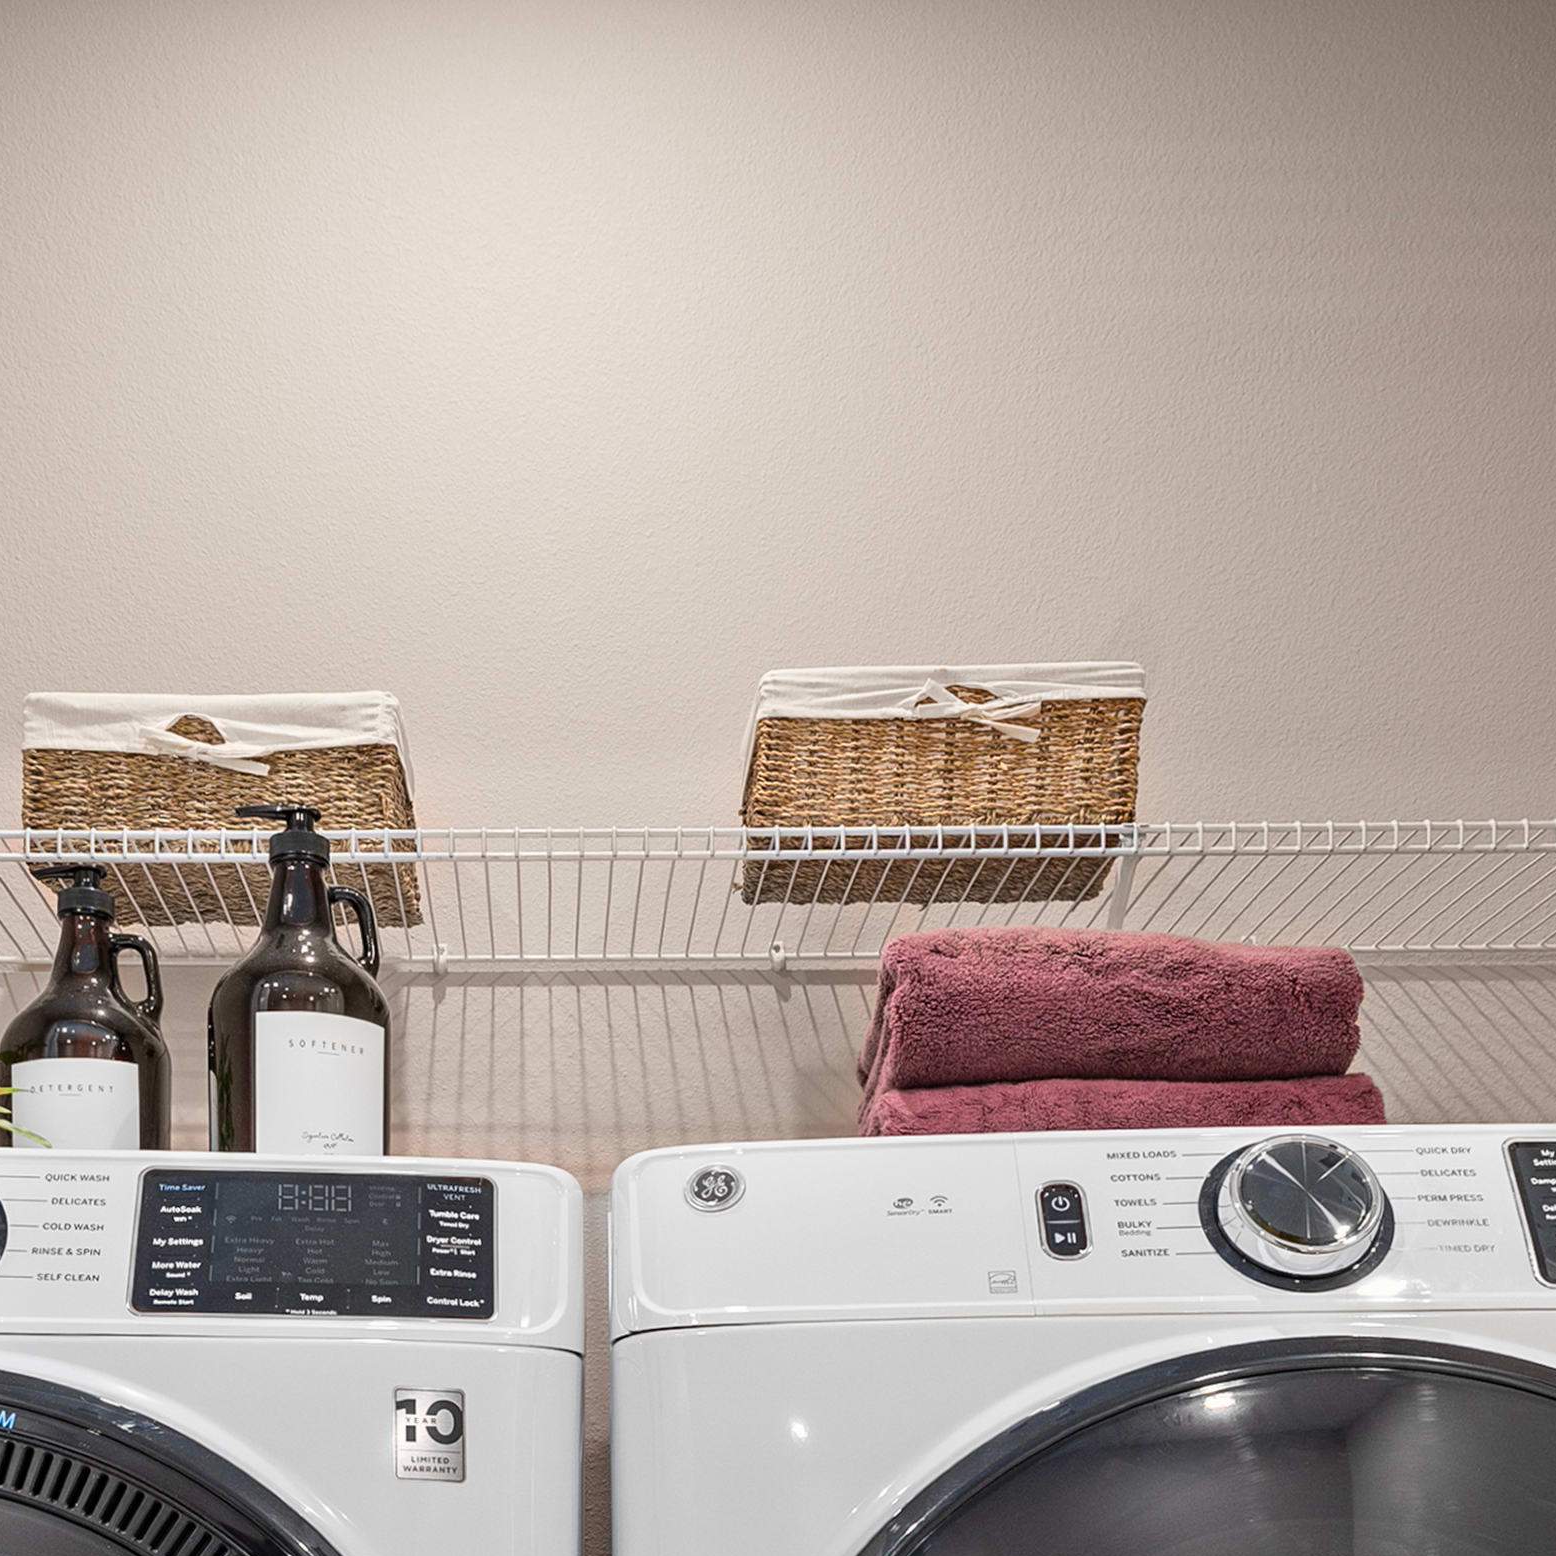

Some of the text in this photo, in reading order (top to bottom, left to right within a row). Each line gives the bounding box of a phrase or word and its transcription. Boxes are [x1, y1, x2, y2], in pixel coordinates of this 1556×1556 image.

[288, 1039, 364, 1055] SOFTENER
[30, 1084, 114, 1094] DETERGENT
[1107, 1151, 1177, 1160] MIXED LOADS
[1415, 1147, 1449, 1155] QUICK
[1540, 1149, 1555, 1158] My
[45, 1173, 110, 1182] QUICK WASH
[1110, 1173, 1161, 1182] COTTONS
[1420, 1169, 1476, 1177] DELICATES
[1530, 1177, 1556, 1185] Damp
[427, 1183, 482, 1193] ULTRAFRESH
[51, 1197, 107, 1206] DELICATES
[1417, 1194, 1484, 1202] PERM PRESS
[1113, 1199, 1157, 1207] TOWELS
[160, 1205, 202, 1214] AutoSoak
[428, 1209, 480, 1221] Tumble Care
[42, 1222, 104, 1232] COLD WASH
[1117, 1221, 1152, 1229] BULKY
[1427, 1218, 1490, 1227] DEWRINKLE
[153, 1238, 204, 1247] My Settings
[426, 1235, 482, 1246] Dryer Control
[31, 1247, 101, 1256] RINSE & SPIN
[1121, 1249, 1170, 1257] SANITIZE
[1438, 1245, 1495, 1253] TIMED DRY
[152, 1261, 201, 1269] More Water
[36, 1273, 100, 1282] SELF CLEAN
[429, 1268, 477, 1279] Extra Rinse
[149, 1288, 199, 1297] Delay Wash
[234, 1292, 253, 1300] Soil
[299, 1292, 324, 1303] Temp
[371, 1295, 392, 1304] Spin
[427, 1297, 458, 1306] Control
[395, 1399, 464, 1445] 10
[411, 1456, 450, 1464] LIMITED
[403, 1465, 458, 1474] WARRANTY
